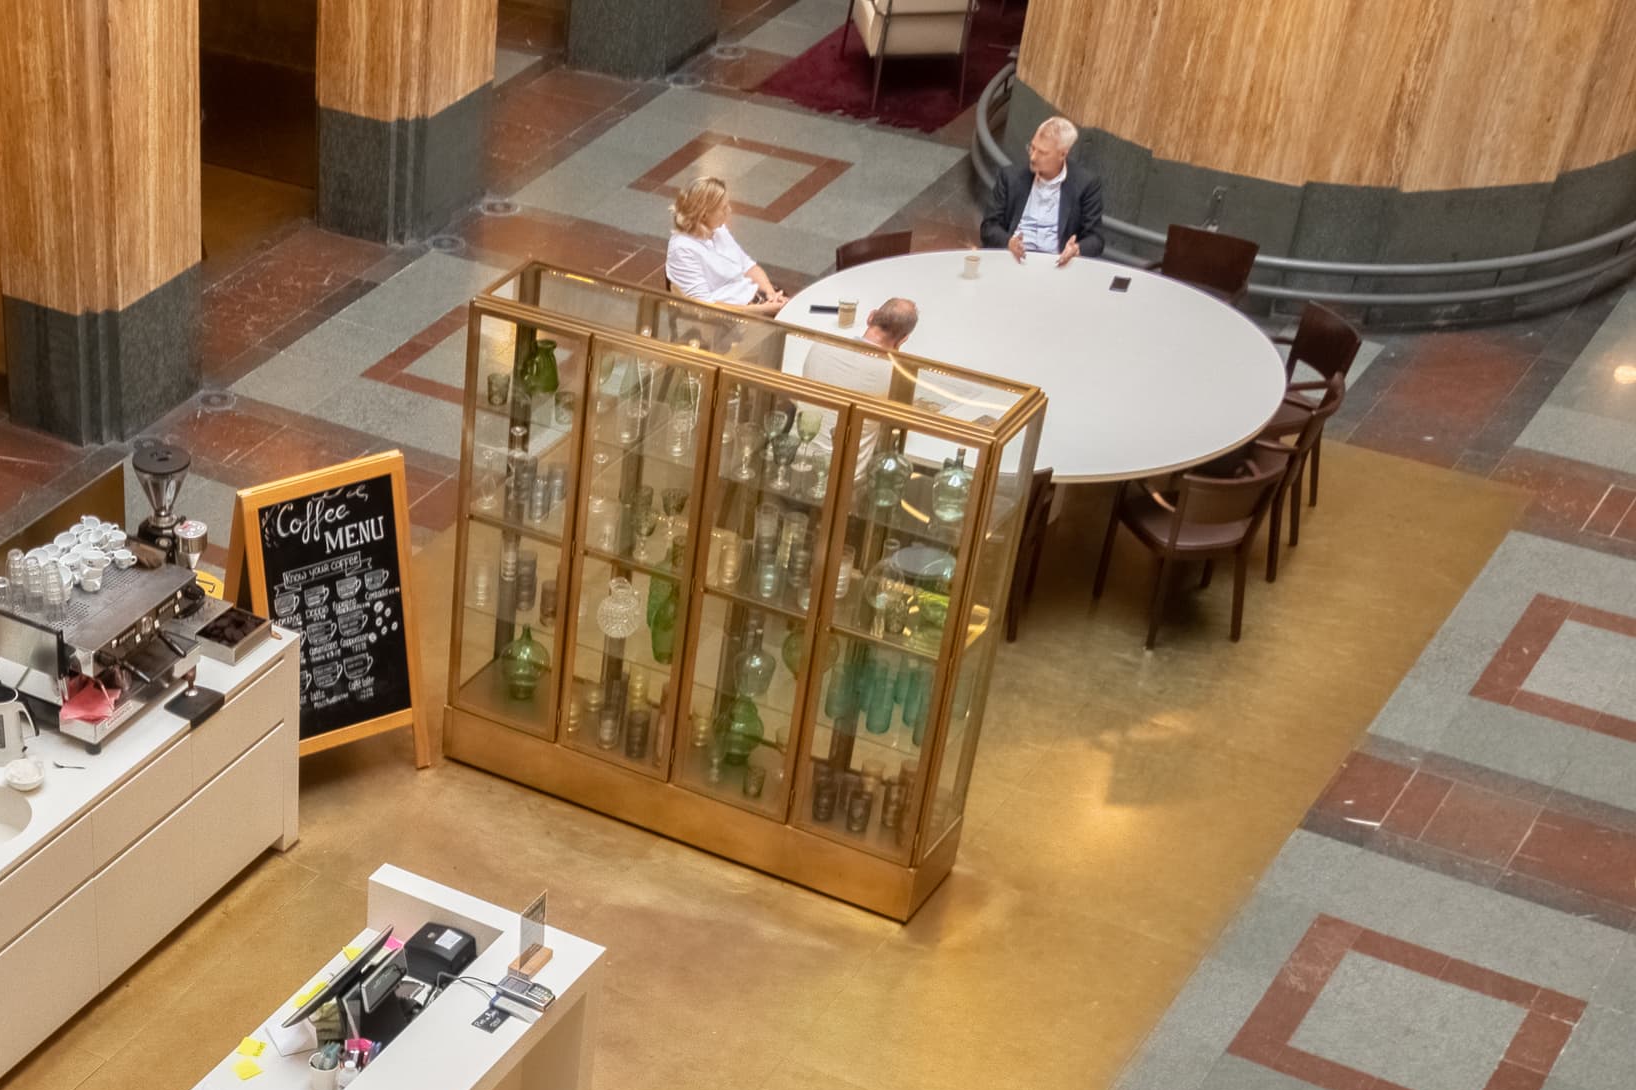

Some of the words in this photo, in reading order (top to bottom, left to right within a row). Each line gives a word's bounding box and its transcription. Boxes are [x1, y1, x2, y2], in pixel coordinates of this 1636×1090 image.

[277, 500, 350, 544] Coffee
[324, 516, 384, 554] MENU
[285, 570, 307, 585] Know
